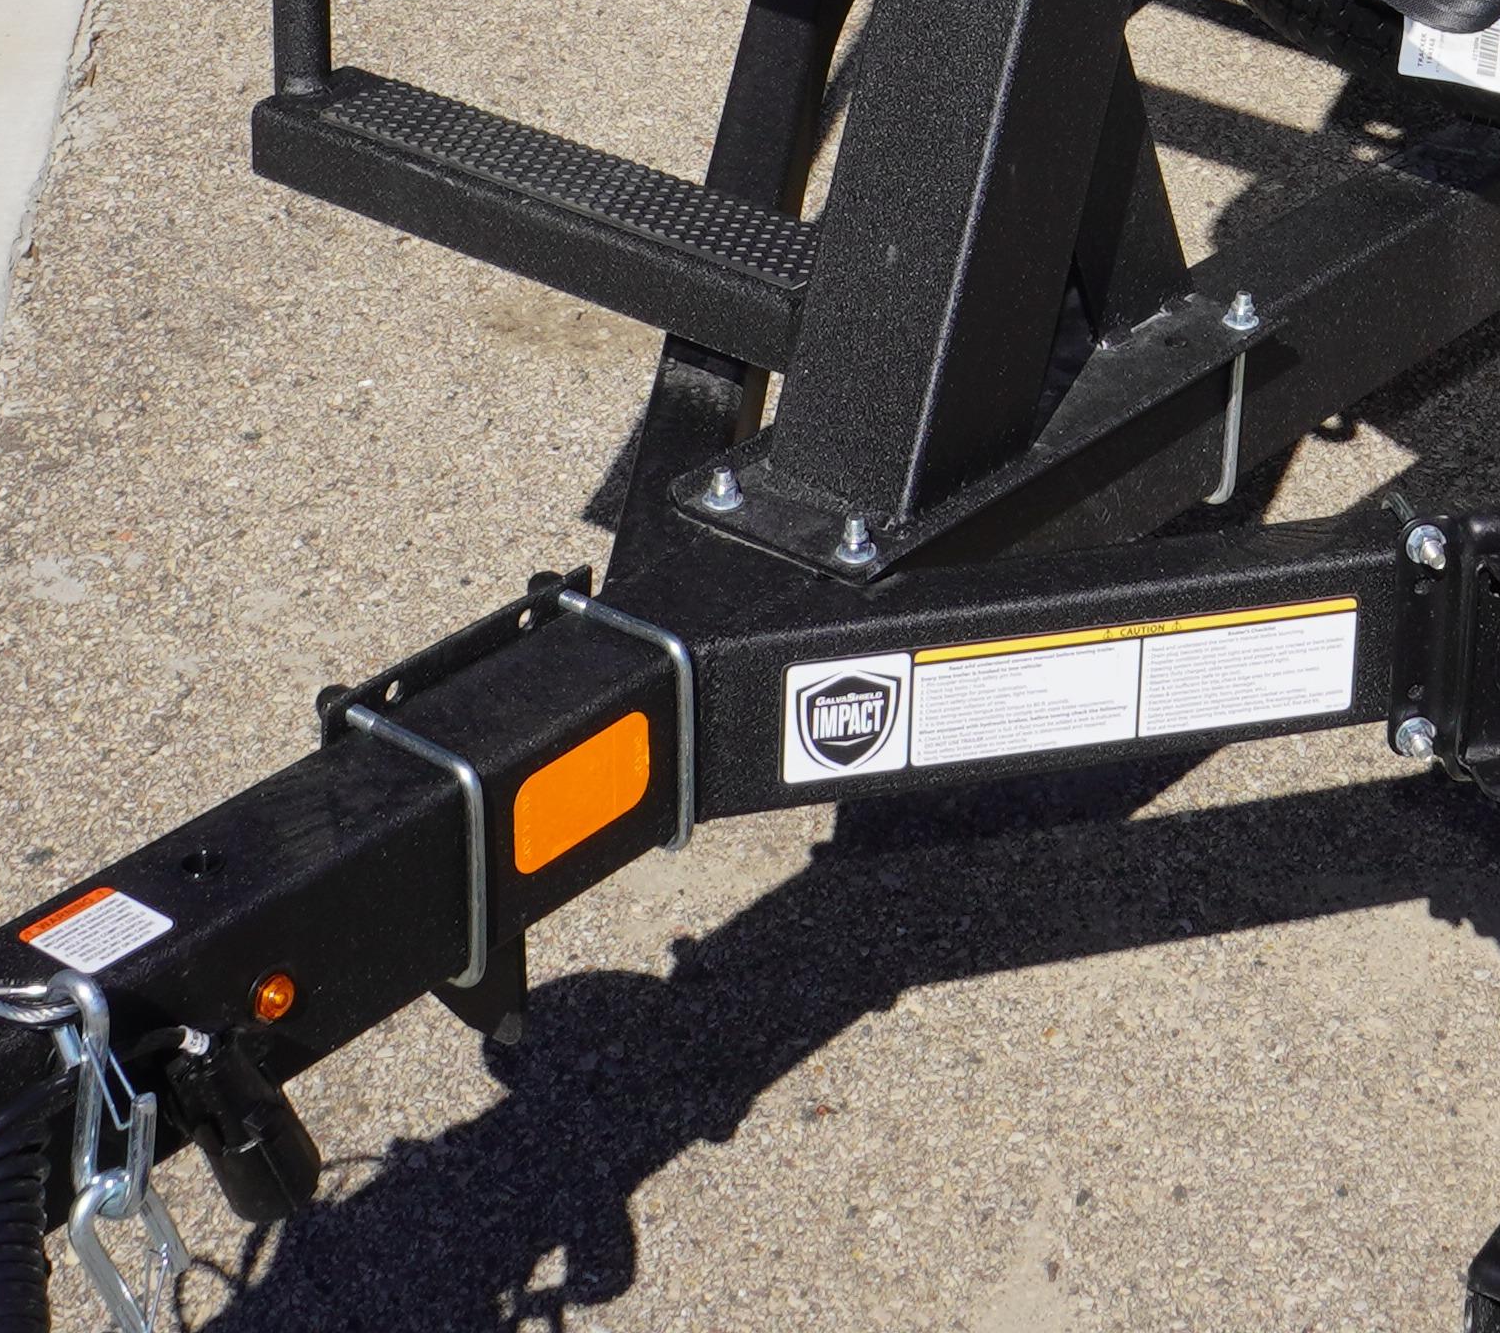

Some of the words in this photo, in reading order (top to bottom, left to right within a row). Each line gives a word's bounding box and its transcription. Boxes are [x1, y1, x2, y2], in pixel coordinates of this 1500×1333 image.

[1120, 623, 1165, 638] CAUTION
[812, 698, 885, 740] IMPACT
[36, 898, 95, 930] WARNING
